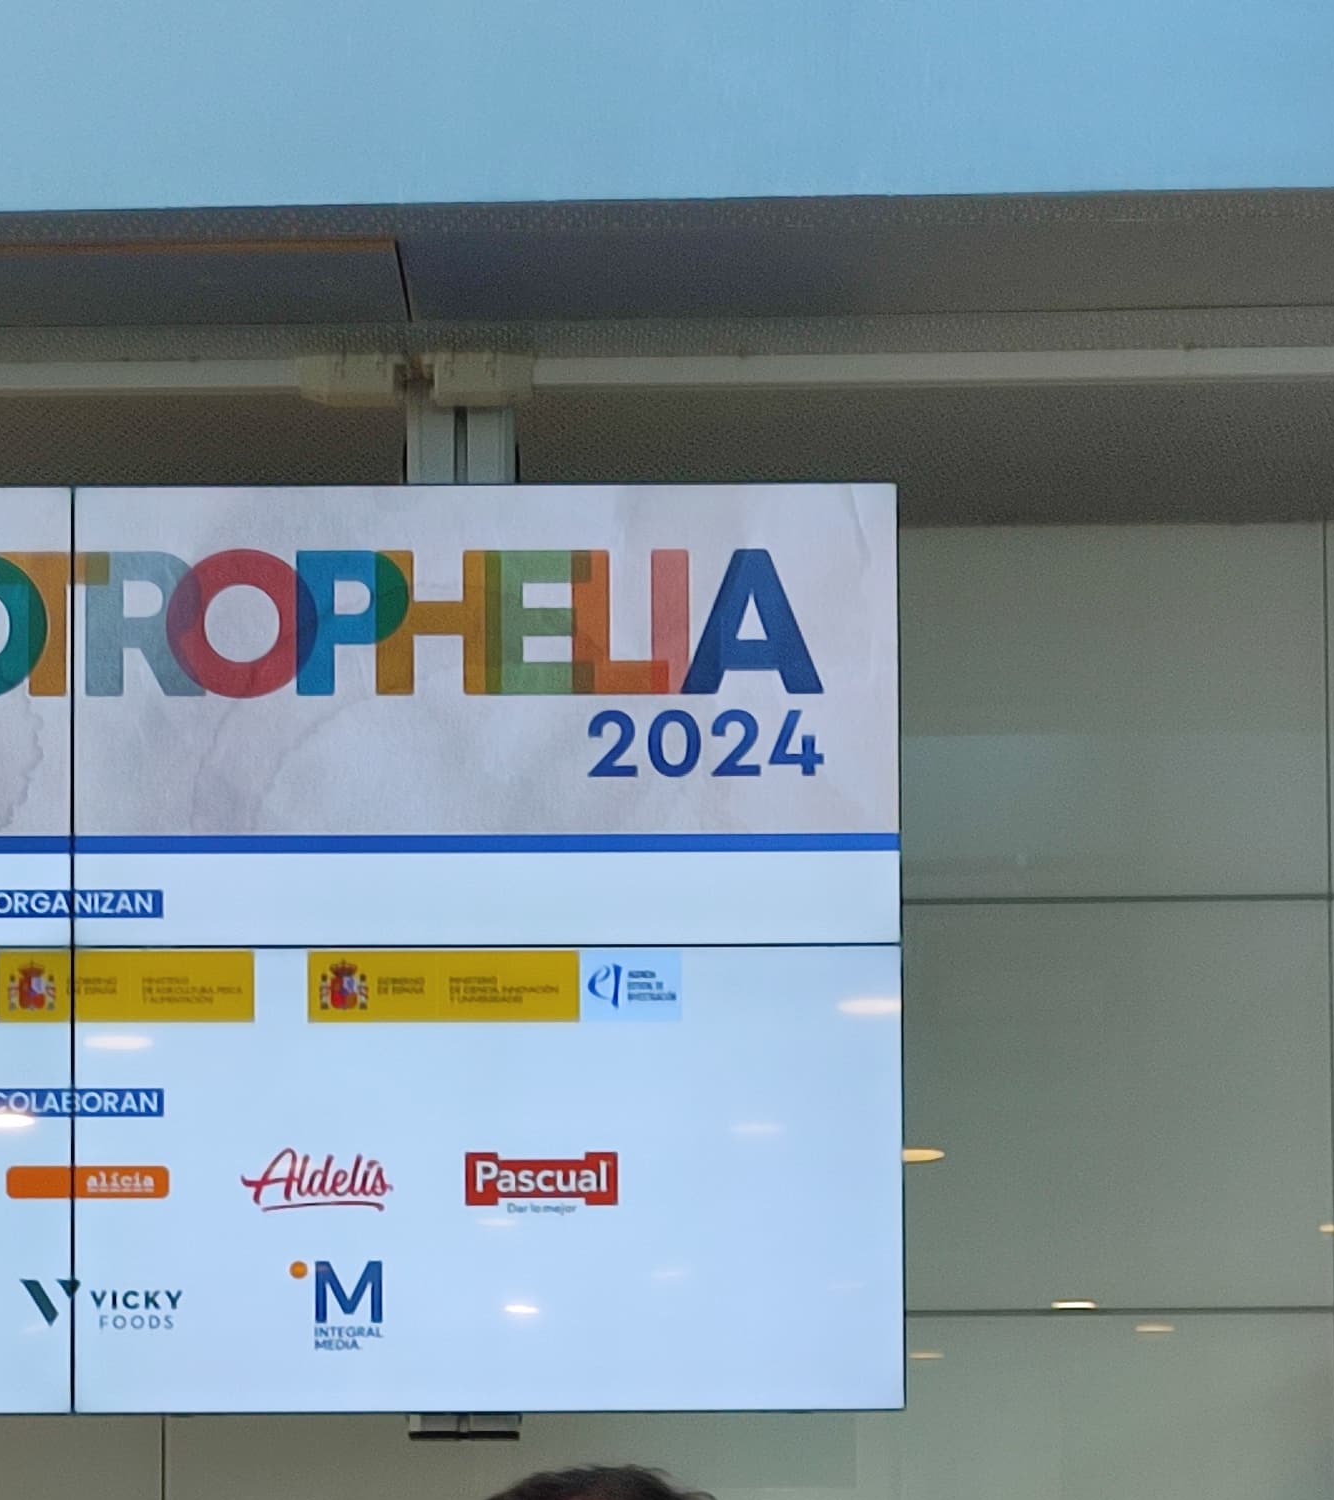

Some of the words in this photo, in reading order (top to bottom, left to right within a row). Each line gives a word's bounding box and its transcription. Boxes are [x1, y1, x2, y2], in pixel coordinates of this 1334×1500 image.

[587, 709, 824, 778] 2024
[475, 1160, 609, 1193] Pascual
[90, 1290, 183, 1310] VICKY
[99, 1315, 174, 1330] FOODS
[314, 1326, 384, 1338] INTEGRAL
[314, 1339, 360, 1351] MEDIA
